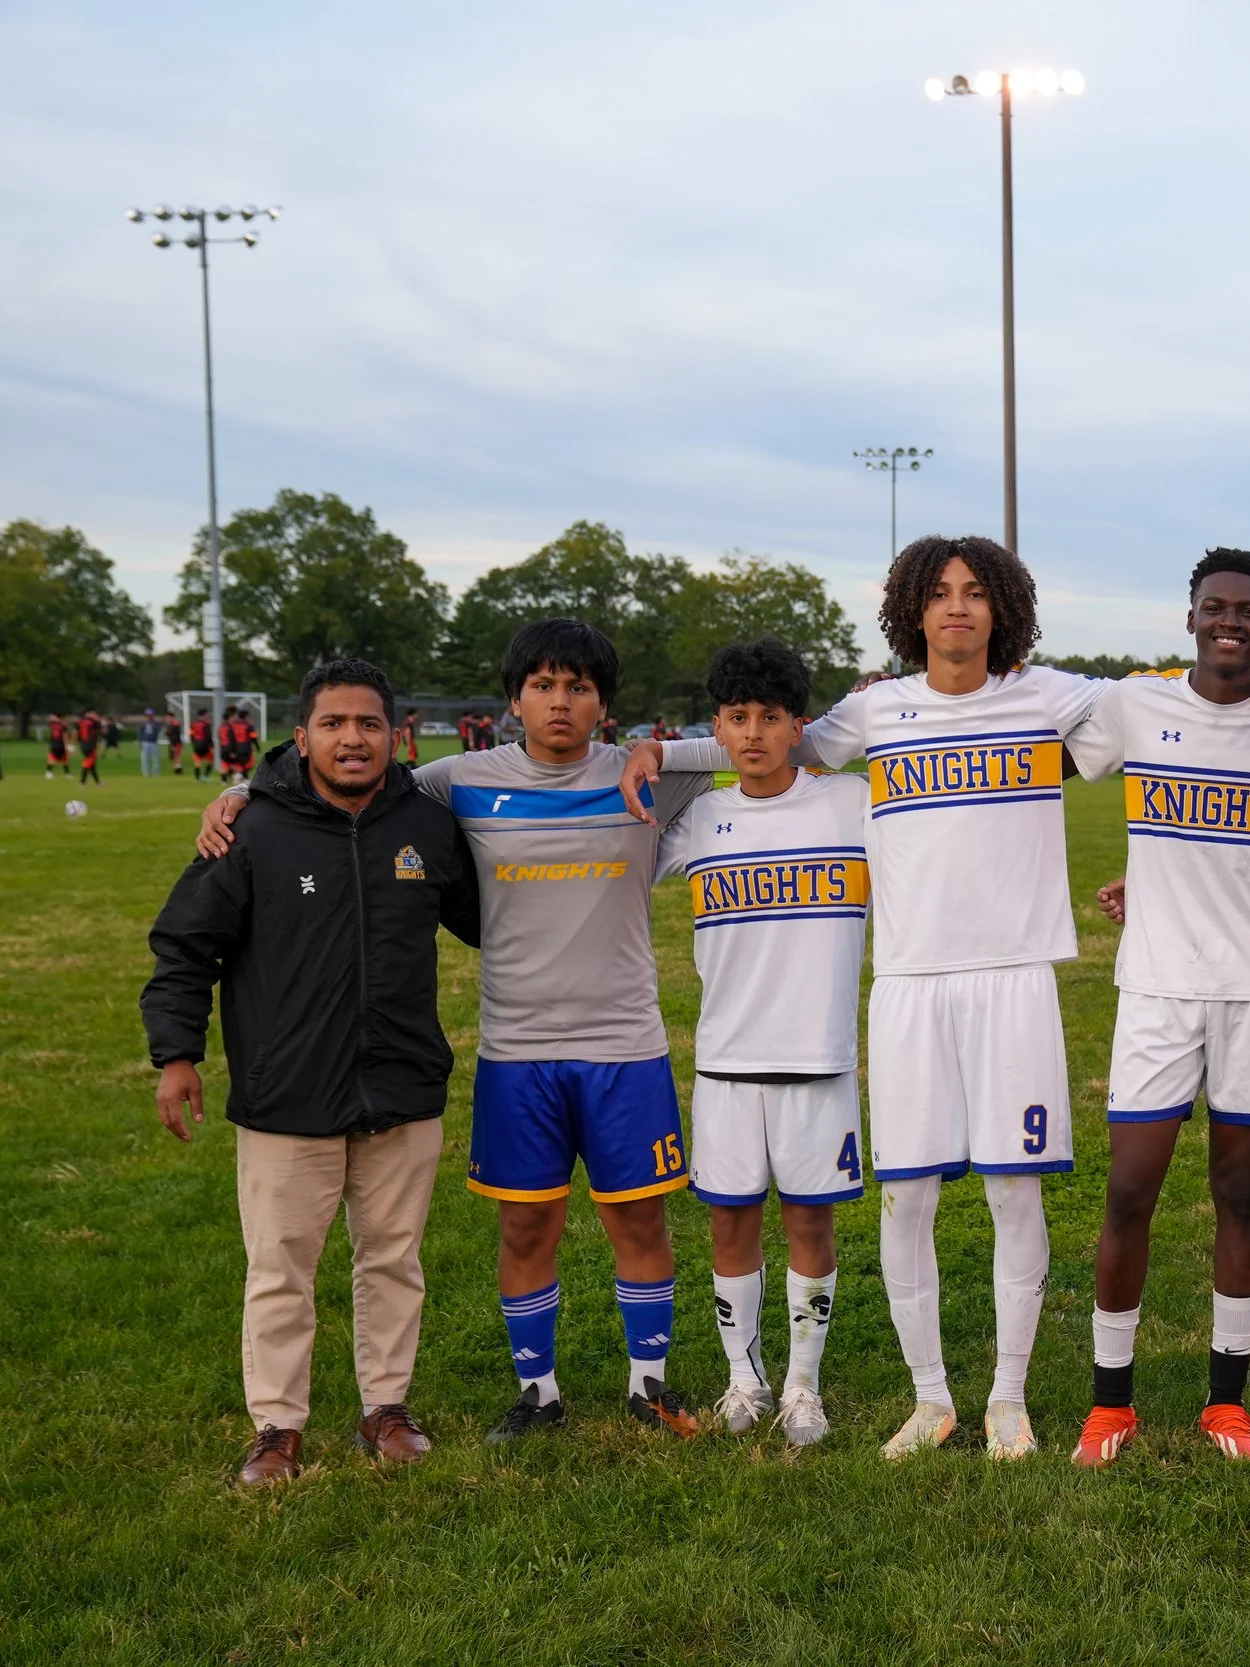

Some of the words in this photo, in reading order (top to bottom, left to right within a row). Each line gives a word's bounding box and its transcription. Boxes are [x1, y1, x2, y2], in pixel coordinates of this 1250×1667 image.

[883, 747, 1033, 797] KNIGHTS
[495, 861, 629, 882] KNIGHTS
[702, 862, 848, 912] KNIGHTS
[651, 1132, 683, 1178] 15
[1023, 1104, 1049, 1156] 9
[836, 1131, 862, 1183] 4
